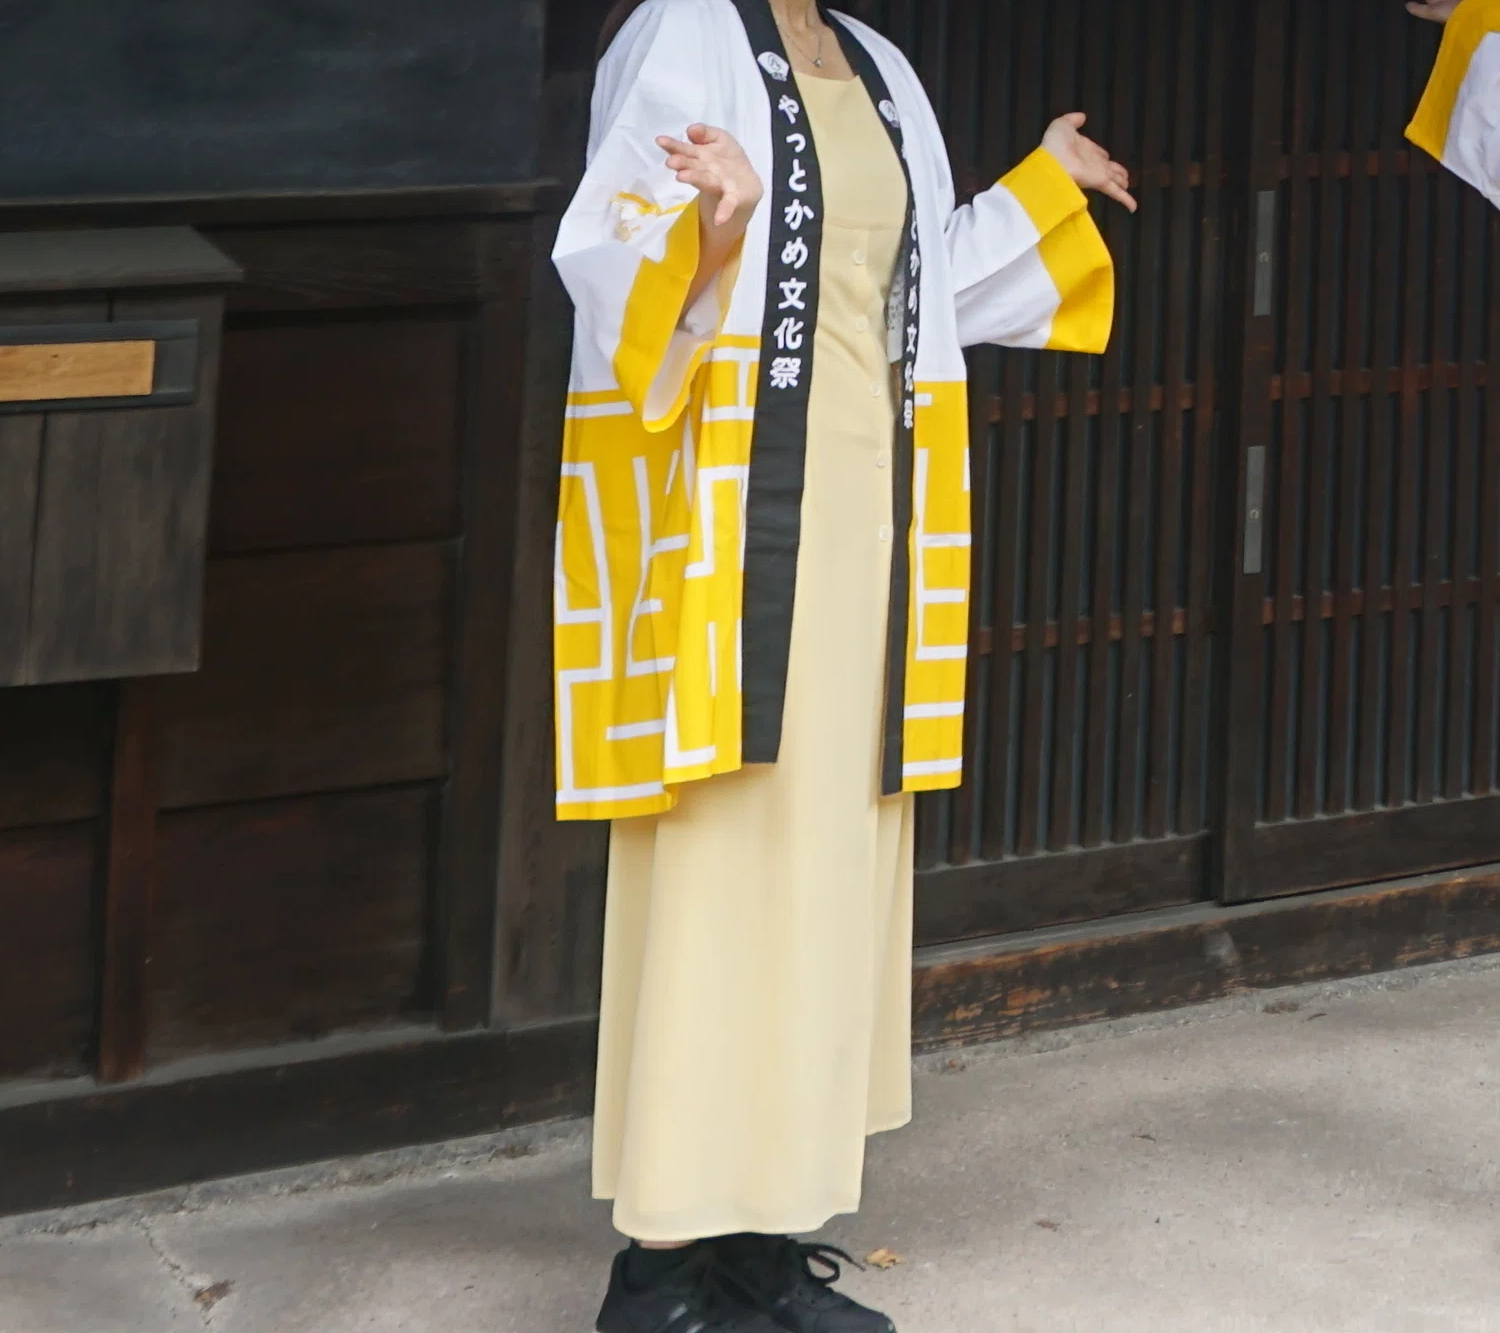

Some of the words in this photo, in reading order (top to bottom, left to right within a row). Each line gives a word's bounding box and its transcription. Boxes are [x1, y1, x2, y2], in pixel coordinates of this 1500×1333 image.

[768, 93, 815, 390] やっとかめ文化祭
